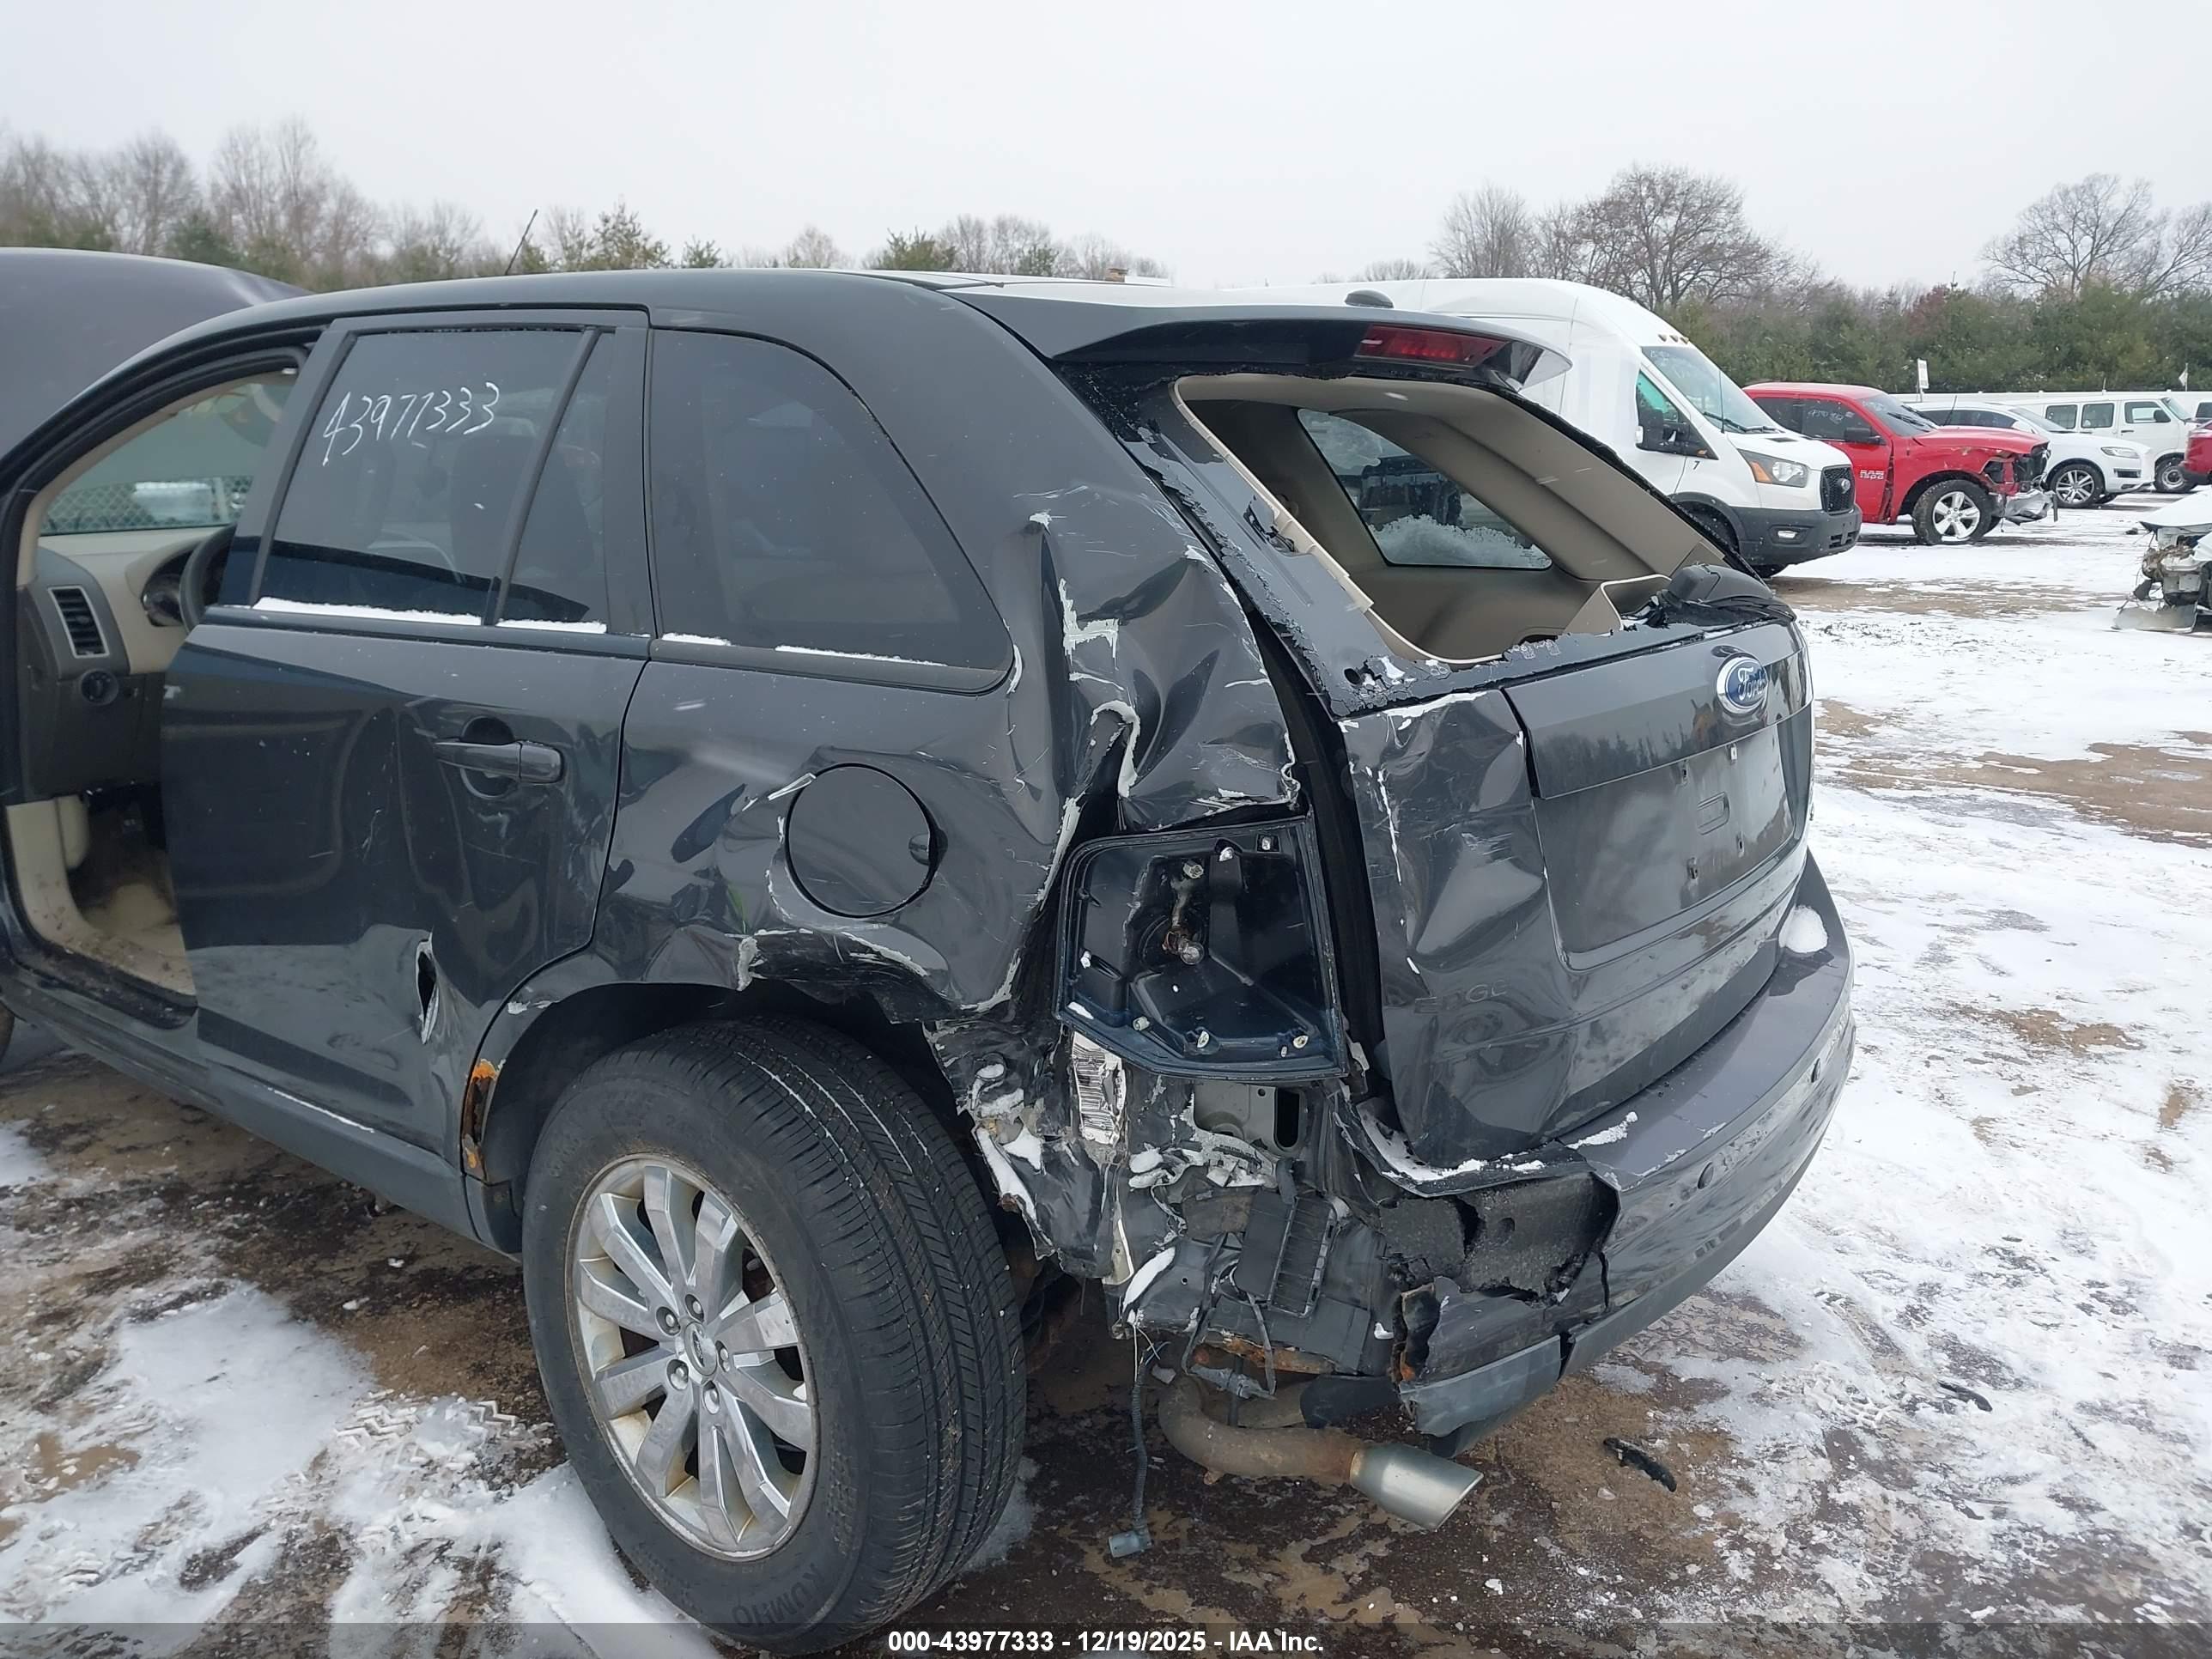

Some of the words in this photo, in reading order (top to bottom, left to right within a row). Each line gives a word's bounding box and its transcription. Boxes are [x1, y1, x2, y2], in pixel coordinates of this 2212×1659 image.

[322, 381, 500, 466] 43977333
[1692, 460, 1700, 470] 7
[1737, 666, 1766, 701] Ford
[731, 1562, 825, 1627] KUMHO
